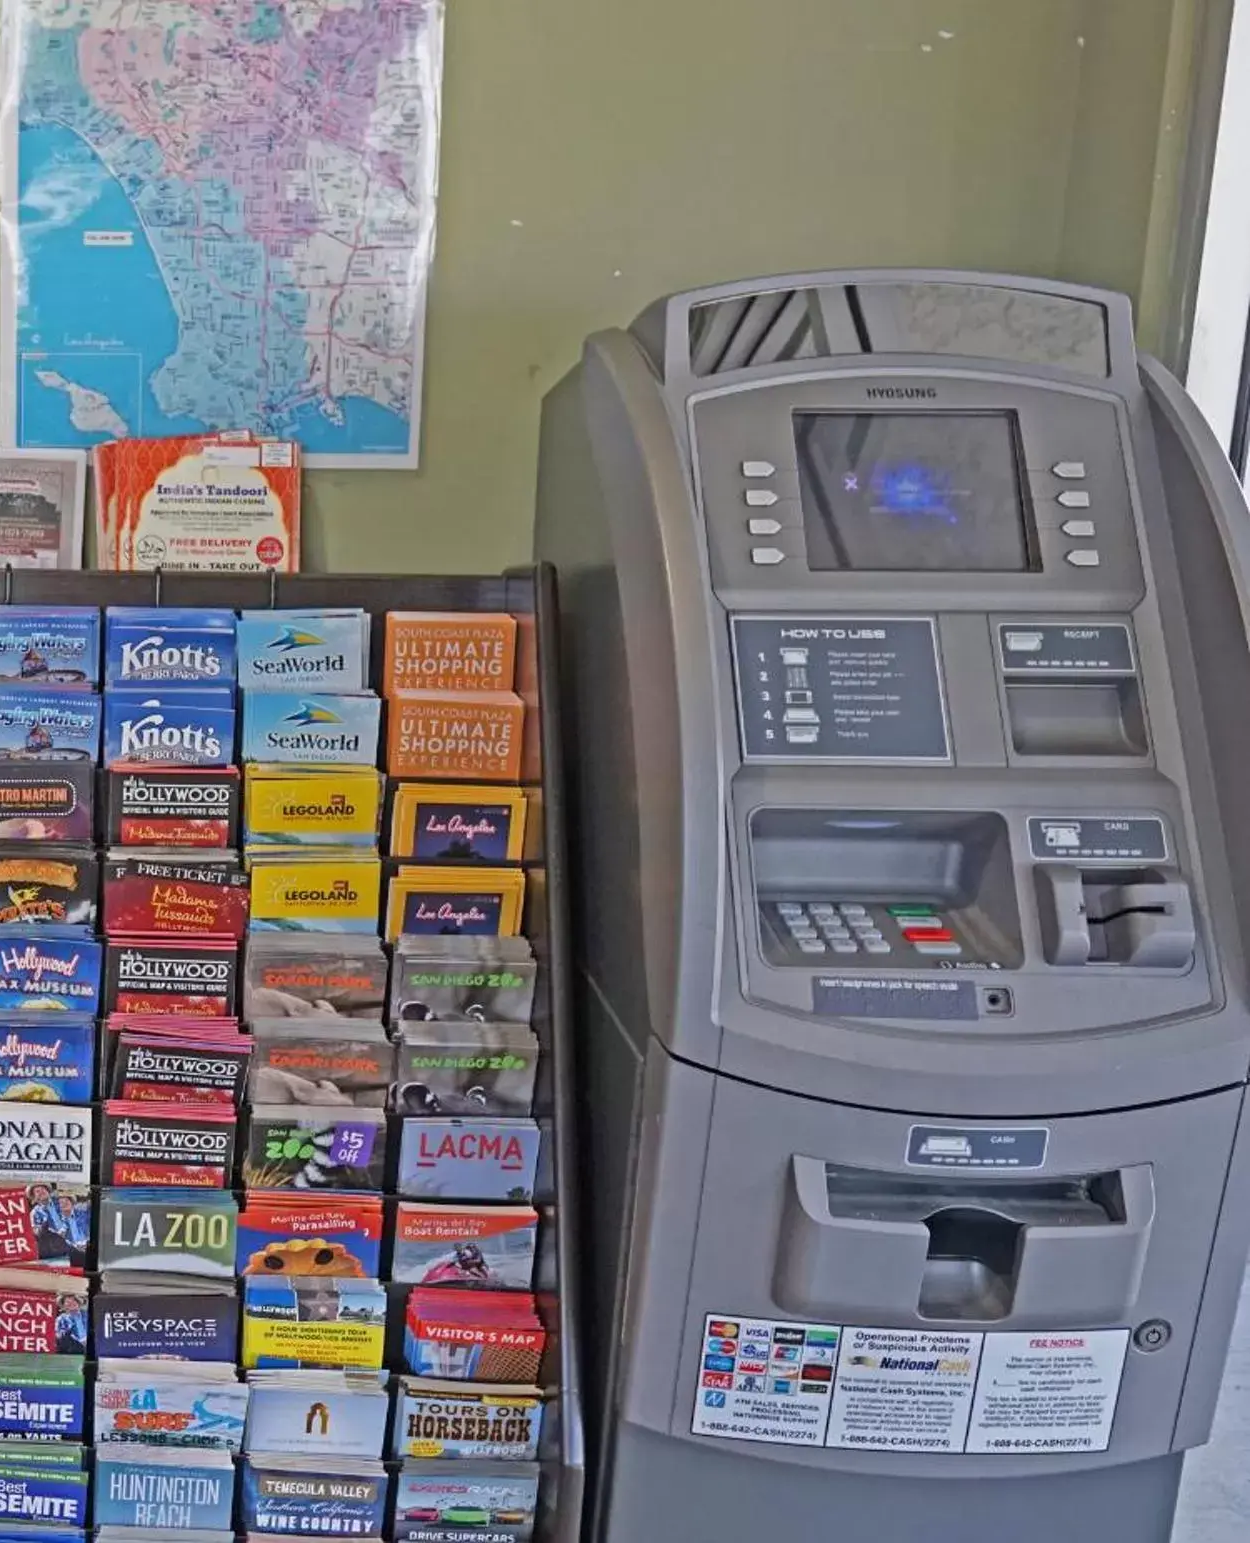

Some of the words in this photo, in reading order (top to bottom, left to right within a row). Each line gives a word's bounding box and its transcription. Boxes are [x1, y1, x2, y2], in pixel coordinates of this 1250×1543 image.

[866, 388, 936, 399] HYOSUNG
[156, 485, 203, 496] India's
[206, 485, 267, 496] Tandoori
[200, 539, 251, 547] DELIVERY
[781, 629, 818, 638] HOW
[821, 630, 845, 638] TO
[849, 630, 886, 639] USE
[396, 641, 503, 658] ULTIMATE
[121, 636, 221, 677] Knott's
[758, 653, 765, 662] 1
[252, 655, 344, 675] SeaWorld
[394, 658, 502, 675] SHOPPING
[760, 672, 768, 681] 2
[762, 691, 771, 701] 3
[763, 710, 773, 720] 4
[401, 719, 511, 739] ULTIMATE
[766, 729, 775, 739] 5
[400, 737, 510, 757] SHOPPING
[123, 787, 229, 802] HOLLYWOOD
[283, 804, 355, 816] LEGOLAND
[137, 862, 175, 878] FREE
[176, 868, 226, 883] TICKET
[285, 888, 358, 901] LEGOLAND
[1, 947, 80, 980] Hollywood
[24, 979, 94, 997] MUSEUM
[8, 1065, 79, 1078] MUSEUM
[418, 1133, 523, 1161] LACMA
[338, 1150, 360, 1162] Off
[114, 1211, 157, 1248] LA
[163, 1213, 228, 1249] ZOO
[404, 1226, 432, 1237] Boat
[435, 1226, 480, 1237] Rentals
[113, 1318, 217, 1332] SKYSPACE
[426, 1325, 497, 1342] VISITOR'S
[501, 1332, 536, 1346] MAP
[745, 1327, 769, 1338] VISA
[855, 1332, 918, 1343] Operational
[920, 1335, 970, 1344] Problems
[853, 1342, 865, 1350] or
[867, 1342, 928, 1353] Suspicious
[930, 1345, 970, 1355] Activity
[1029, 1338, 1048, 1348] FEE
[1051, 1339, 1085, 1347] NOTICE
[840, 1384, 878, 1393] National
[880, 1385, 903, 1394] Cash
[906, 1388, 947, 1397] Systems,
[949, 1389, 966, 1397] Inc.
[416, 1402, 488, 1417] TOURS
[497, 1407, 525, 1417] ON
[407, 1415, 532, 1442] HORSEBACK
[109, 1473, 220, 1504] HUNTINGTON
[266, 1481, 325, 1495] TEMECULA
[330, 1485, 370, 1498] VALLEY
[409, 1531, 444, 1541] DRIVE
[446, 1532, 515, 1542] SUPERCARS
